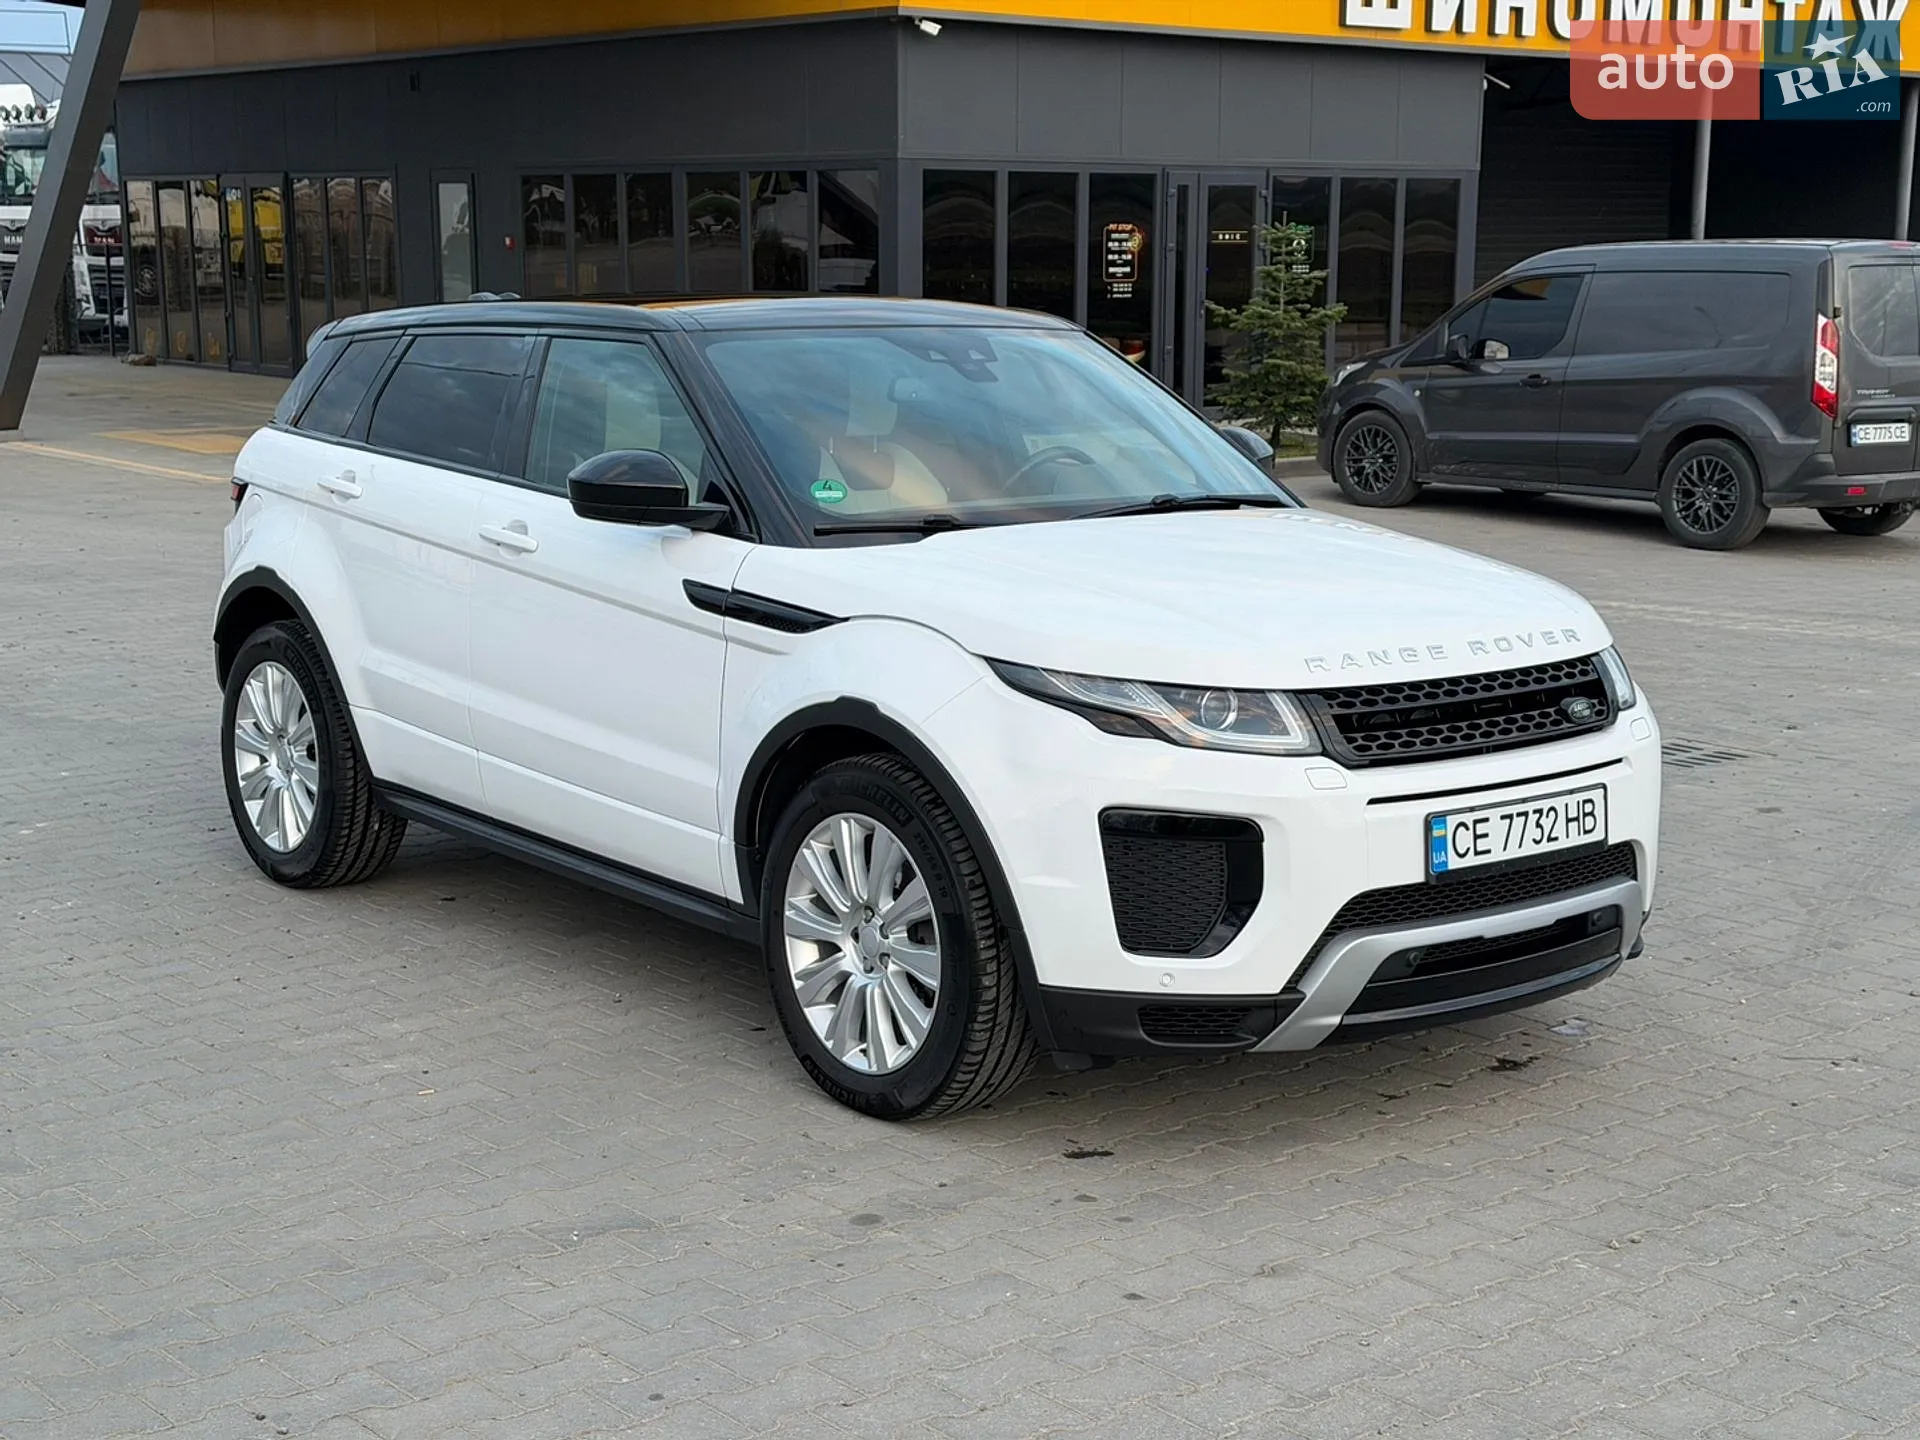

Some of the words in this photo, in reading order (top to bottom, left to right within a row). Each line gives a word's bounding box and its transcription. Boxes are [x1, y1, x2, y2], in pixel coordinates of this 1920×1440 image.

[4, 235, 23, 246] MAN
[1858, 427, 1871, 440] CE
[1894, 425, 1906, 439] CE
[1304, 644, 1449, 674] RANGE
[1467, 628, 1582, 656] ROVER
[1452, 817, 1492, 859] CE
[1500, 805, 1559, 853] 7732
[1564, 798, 1598, 839] HB
[1433, 852, 1447, 864] UA
